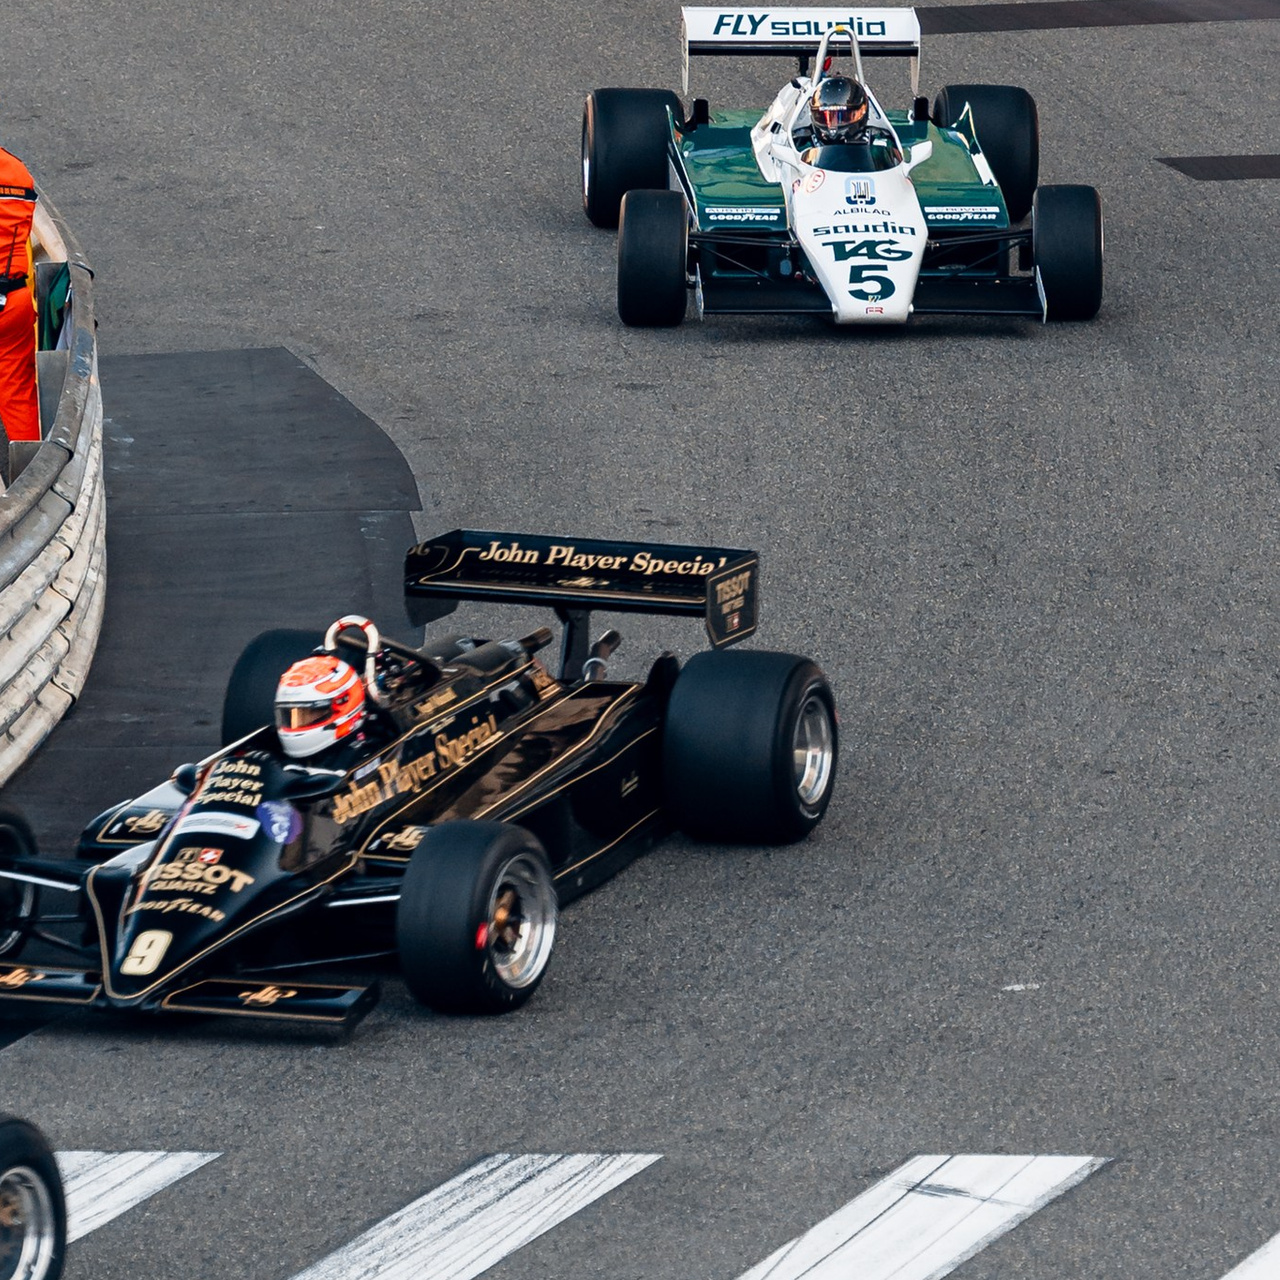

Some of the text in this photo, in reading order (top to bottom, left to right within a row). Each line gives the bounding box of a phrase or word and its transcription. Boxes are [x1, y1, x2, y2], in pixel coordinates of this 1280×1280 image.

[713, 13, 885, 37] FLY saudia
[709, 213, 778, 222] GOODYEAR
[927, 212, 997, 222] GOODYEAR
[812, 220, 916, 237] saudia
[822, 237, 913, 262] TAG
[848, 264, 896, 301] 5
[479, 540, 539, 566] John
[543, 545, 628, 571] Player
[217, 758, 261, 776] John
[332, 714, 498, 825] John Player Special
[209, 775, 264, 792] Player
[196, 789, 262, 807] Special
[121, 929, 173, 976] 9
